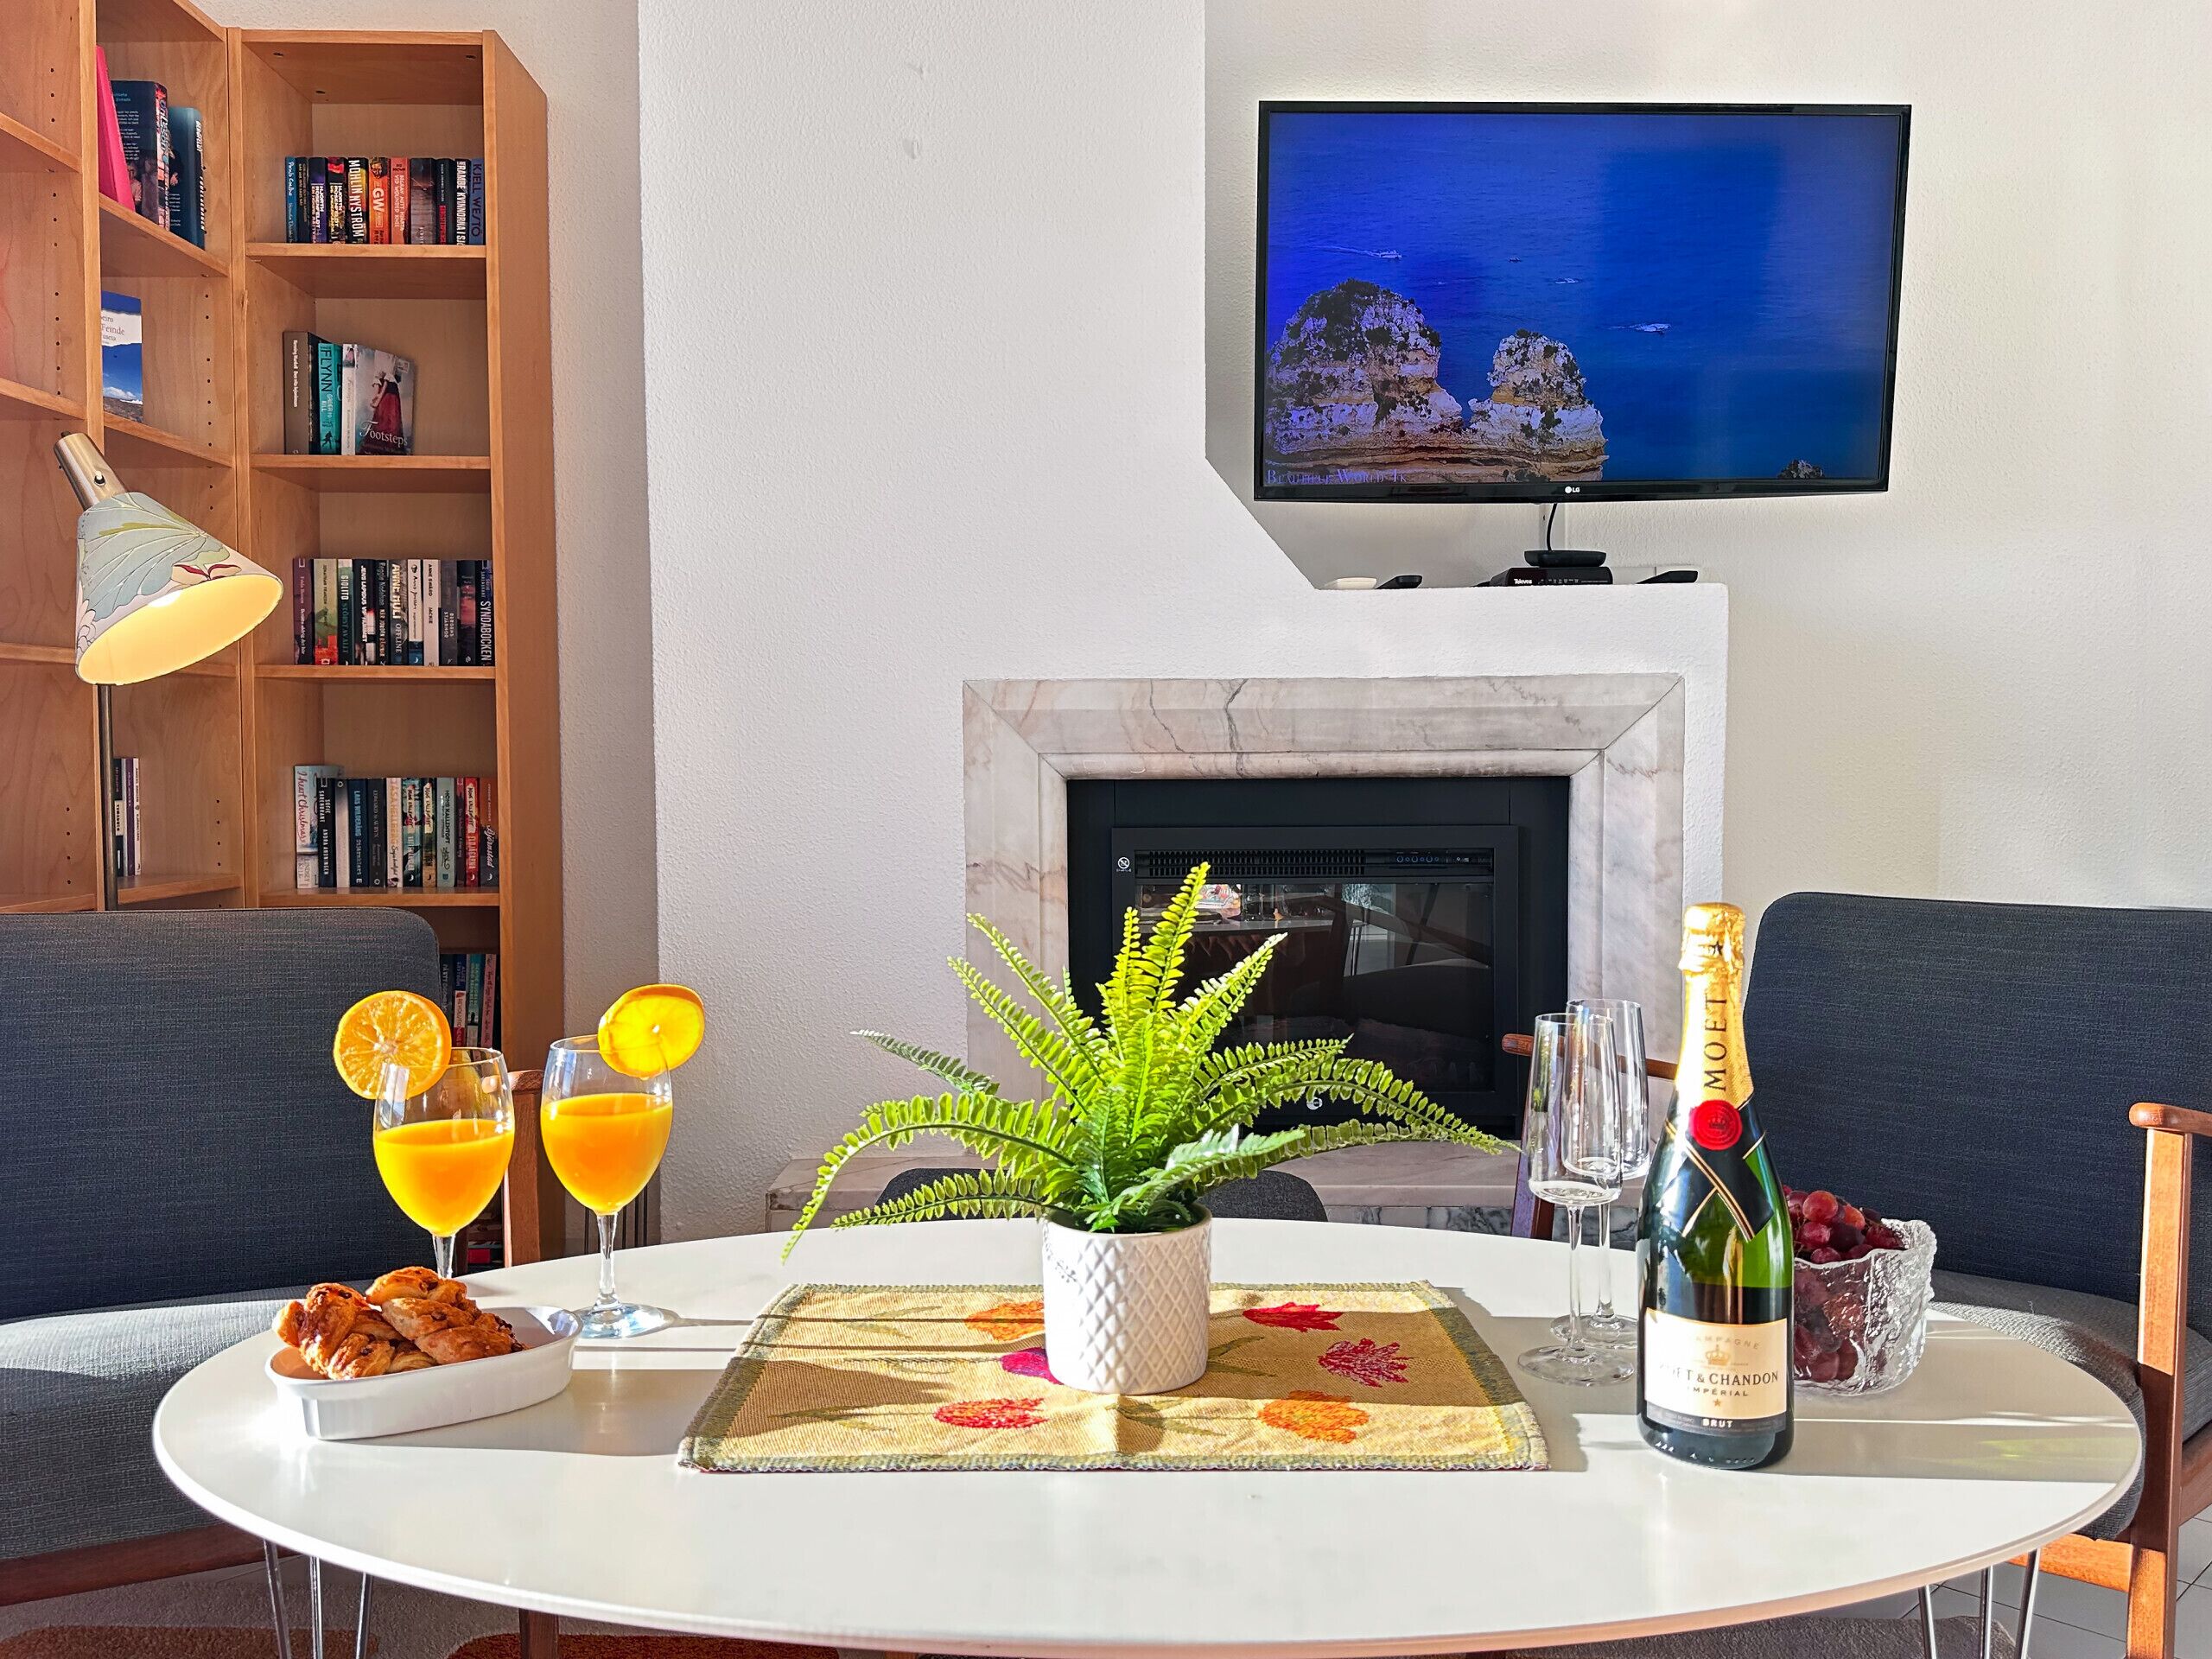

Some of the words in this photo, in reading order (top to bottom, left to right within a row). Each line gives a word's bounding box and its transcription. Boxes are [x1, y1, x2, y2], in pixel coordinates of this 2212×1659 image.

[348, 160, 363, 194] MOHLIN
[472, 163, 482, 194] KJELL
[372, 188, 385, 213] GW
[348, 195, 365, 237] NYSTRÖM
[471, 196, 483, 236] WESTÖ
[321, 349, 332, 392] FLYNN
[359, 420, 409, 448] Footsteps
[377, 562, 386, 581] Reggie
[391, 563, 402, 593] ANNE
[340, 575, 349, 601] GIOLITO
[480, 601, 493, 661] SYNDABOCKEN
[297, 775, 308, 798] heart
[297, 799, 308, 842] Christmas
[483, 825, 495, 868] Björnstad
[1697, 1374, 1705, 1383] &
[1708, 1370, 1779, 1386] CHANDON
[1702, 1418, 1733, 1428] BRUT
